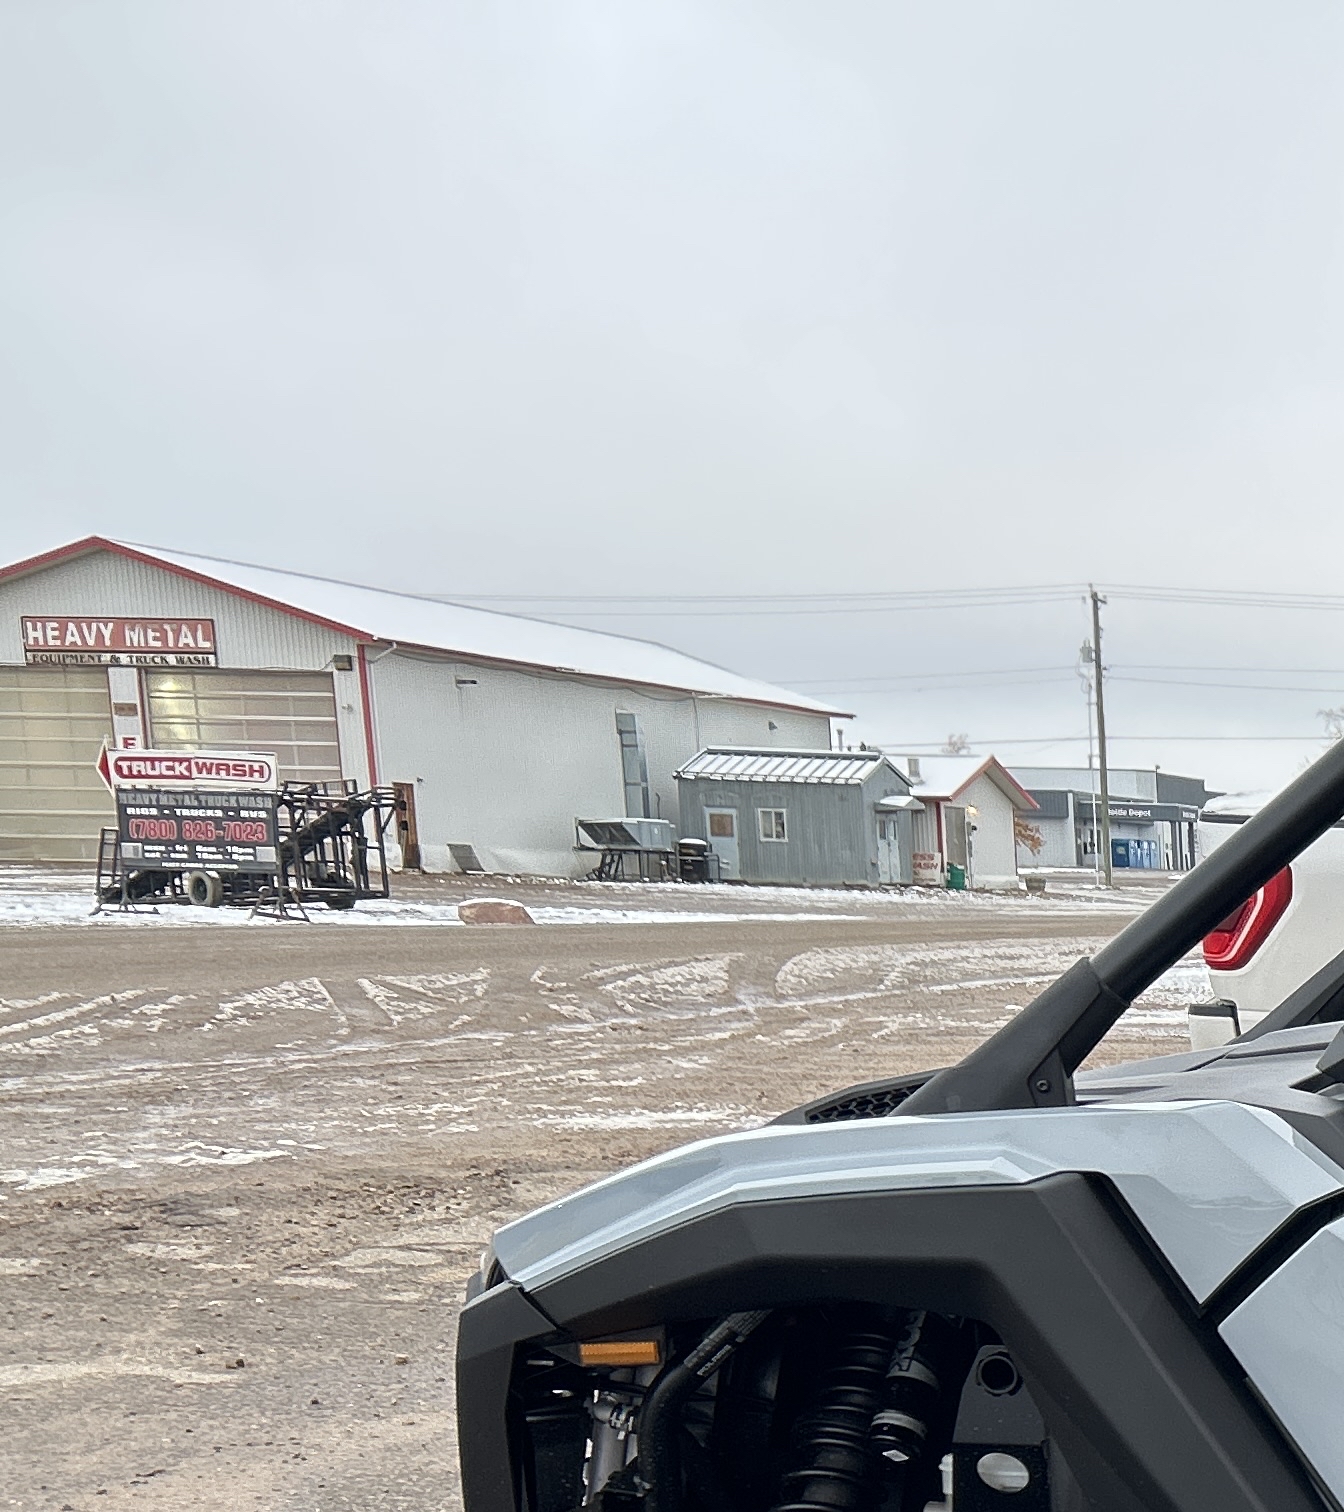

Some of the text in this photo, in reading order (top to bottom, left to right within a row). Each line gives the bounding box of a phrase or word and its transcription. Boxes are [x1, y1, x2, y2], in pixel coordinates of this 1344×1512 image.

[26, 621, 211, 648] HEAVY METAL
[32, 654, 210, 665] EQUIPMENT & TRUCK WASH
[117, 760, 264, 779] TRUCK WASH
[118, 792, 272, 808] HEAVY METAL TRUCK WASH
[174, 808, 223, 817] TRUCKS
[129, 819, 267, 842] (780) 826-7023
